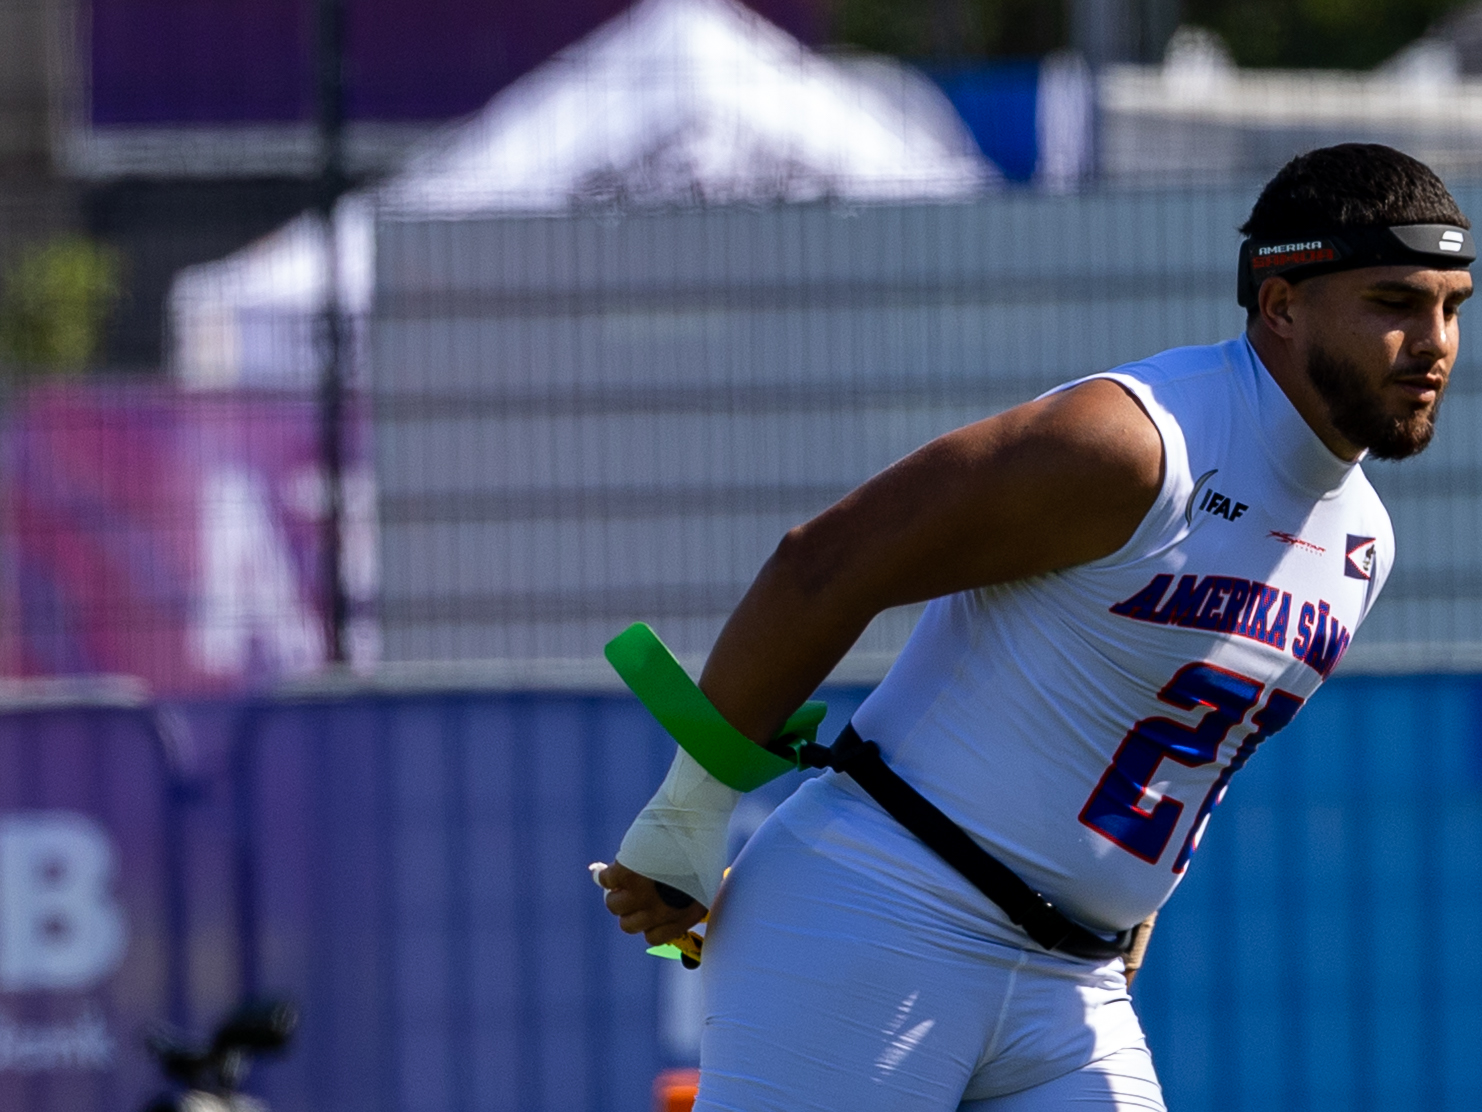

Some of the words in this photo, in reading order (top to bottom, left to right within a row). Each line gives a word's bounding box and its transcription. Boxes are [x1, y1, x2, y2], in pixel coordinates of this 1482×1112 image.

[1252, 249, 1334, 269] SAMOA
[1258, 240, 1322, 256] AMERIKA
[1199, 488, 1249, 522] IFAF
[1109, 573, 1292, 651] AMERIKA
